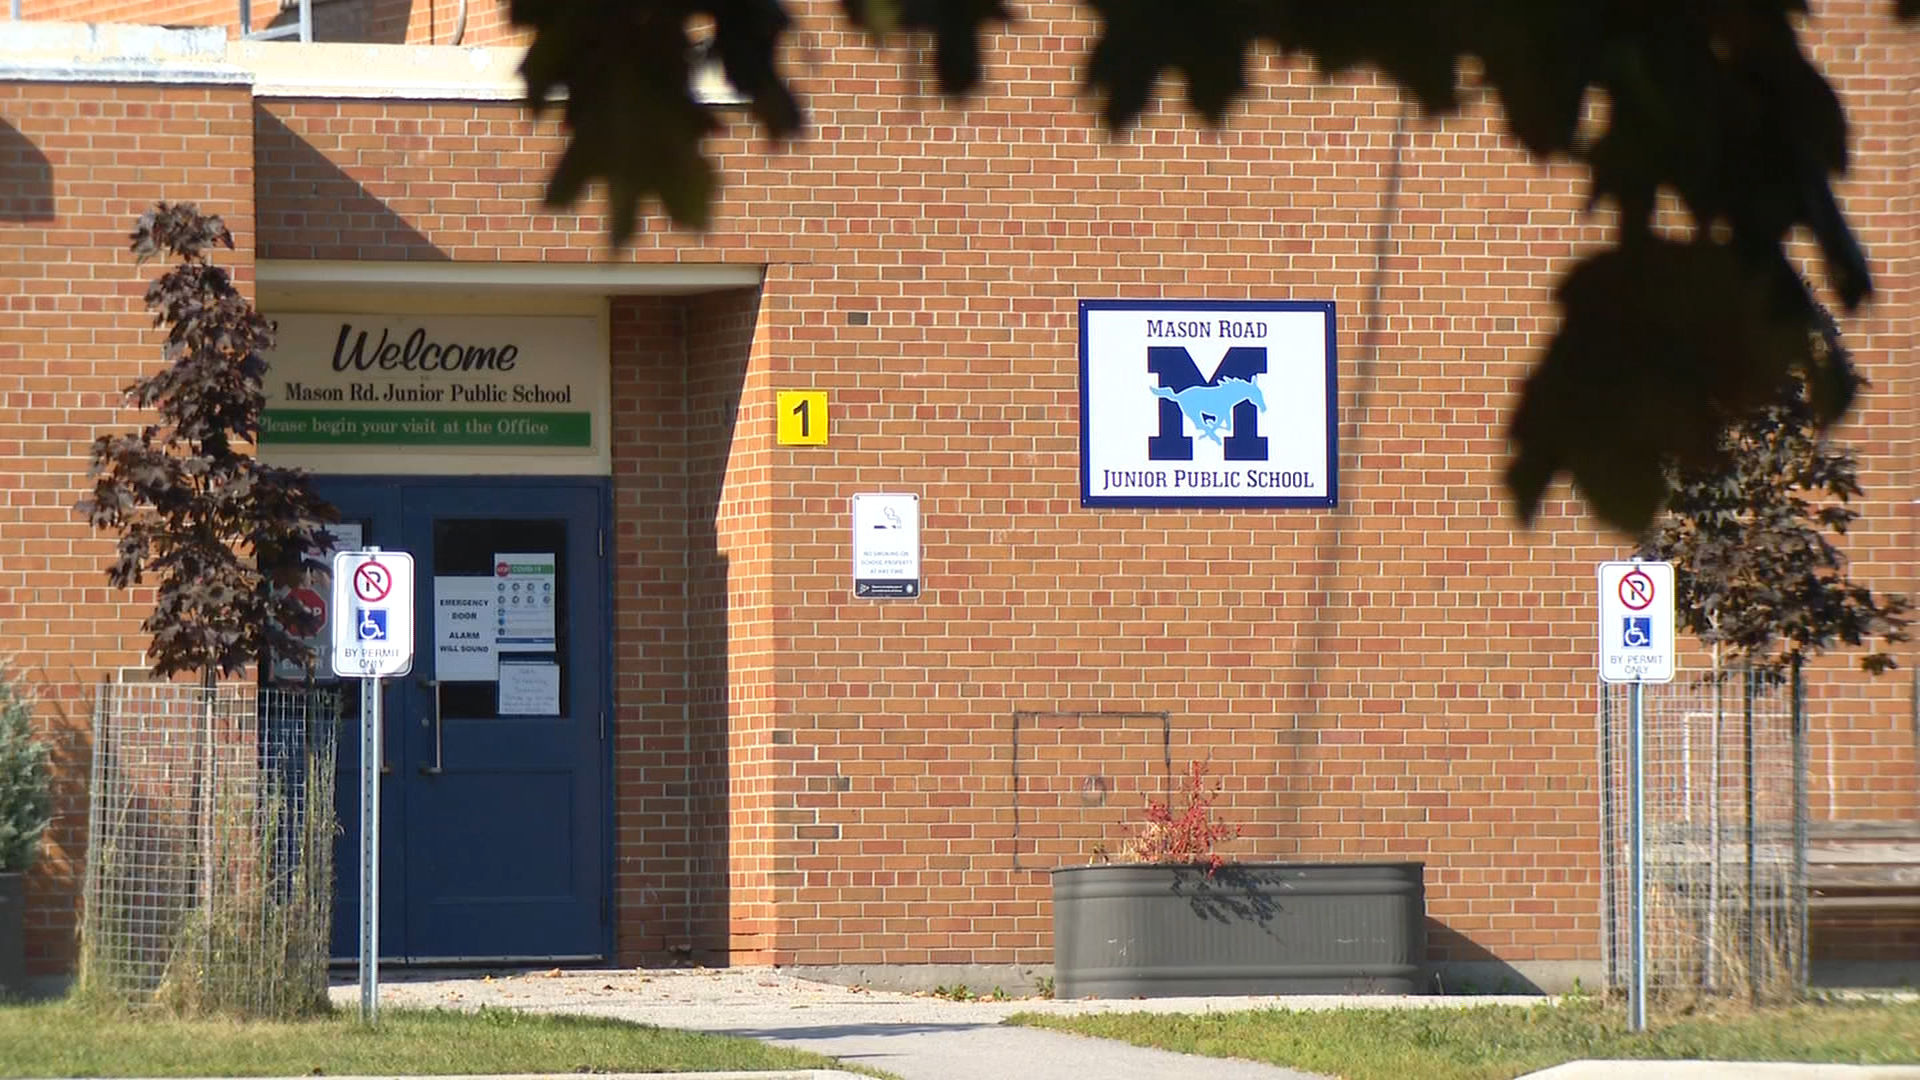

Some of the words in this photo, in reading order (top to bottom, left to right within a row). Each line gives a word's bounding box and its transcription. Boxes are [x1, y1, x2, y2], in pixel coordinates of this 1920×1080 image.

[1146, 319, 1211, 338] MASON
[1218, 320, 1268, 339] ROAD
[331, 323, 519, 373] Welcome
[285, 382, 343, 402] Mason
[350, 383, 380, 402] Rd.
[383, 383, 445, 402] Junior
[450, 384, 507, 403] Public
[512, 385, 572, 404] School
[793, 399, 809, 437] 1
[312, 416, 356, 437] begin
[361, 419, 398, 438] your
[401, 417, 436, 434] visit
[443, 419, 461, 434] at
[465, 417, 492, 434] the
[497, 418, 550, 435] Office
[1102, 469, 1168, 490] JUNIOR
[1174, 469, 1241, 489] PUBLIC
[1247, 469, 1315, 489] SCHOOL
[439, 599, 489, 607] EMERGENCY
[451, 612, 477, 620] DOOR
[448, 631, 480, 639] ALARM
[344, 647, 358, 658] BY
[361, 647, 400, 658] PERMIT
[440, 645, 459, 653] WILL
[461, 645, 489, 653] SOUND
[1610, 655, 1623, 664] BY
[1627, 655, 1664, 664] PERMIT
[1624, 665, 1649, 674] ONLY
